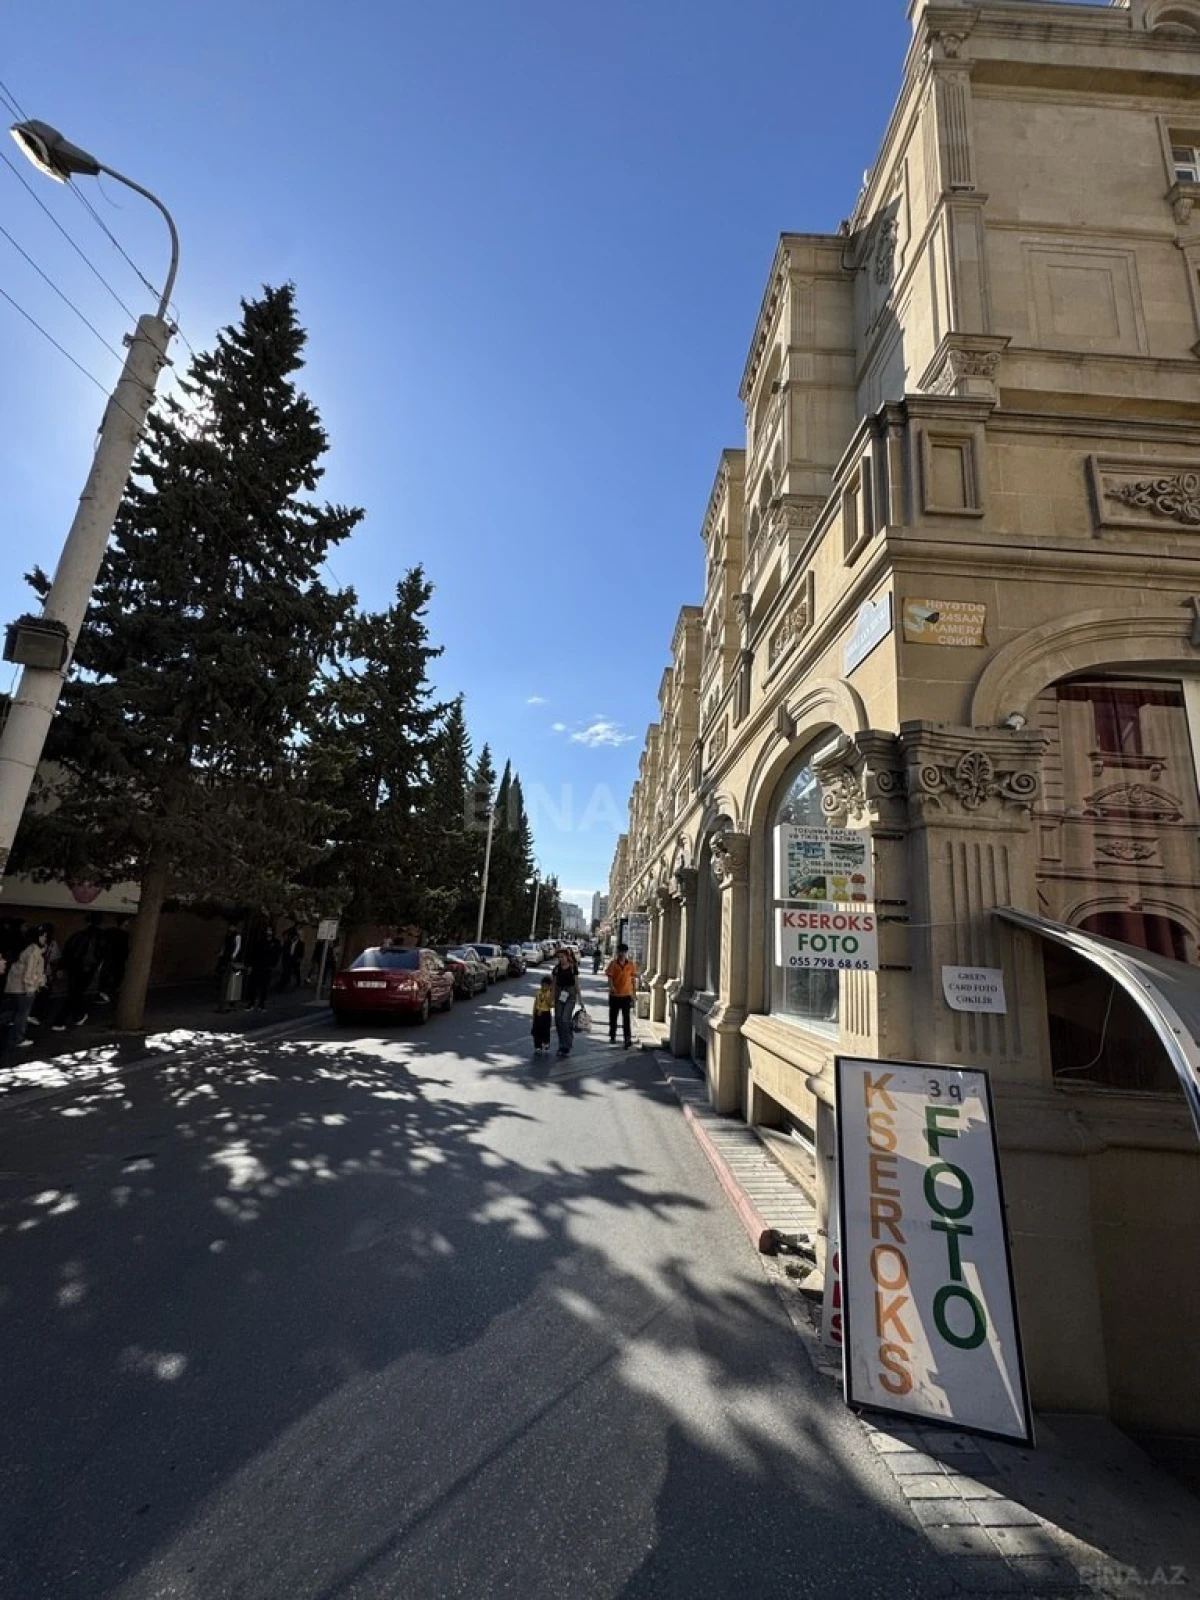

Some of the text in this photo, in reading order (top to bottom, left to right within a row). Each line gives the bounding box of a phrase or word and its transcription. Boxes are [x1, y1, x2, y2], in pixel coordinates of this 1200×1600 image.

[783, 912, 873, 932] KSEROKS
[798, 933, 859, 954] FOTO
[789, 956, 870, 970] 055 798 68 65
[863, 1071, 913, 1396] KSEROKS
[923, 1105, 987, 1350] FOTO
